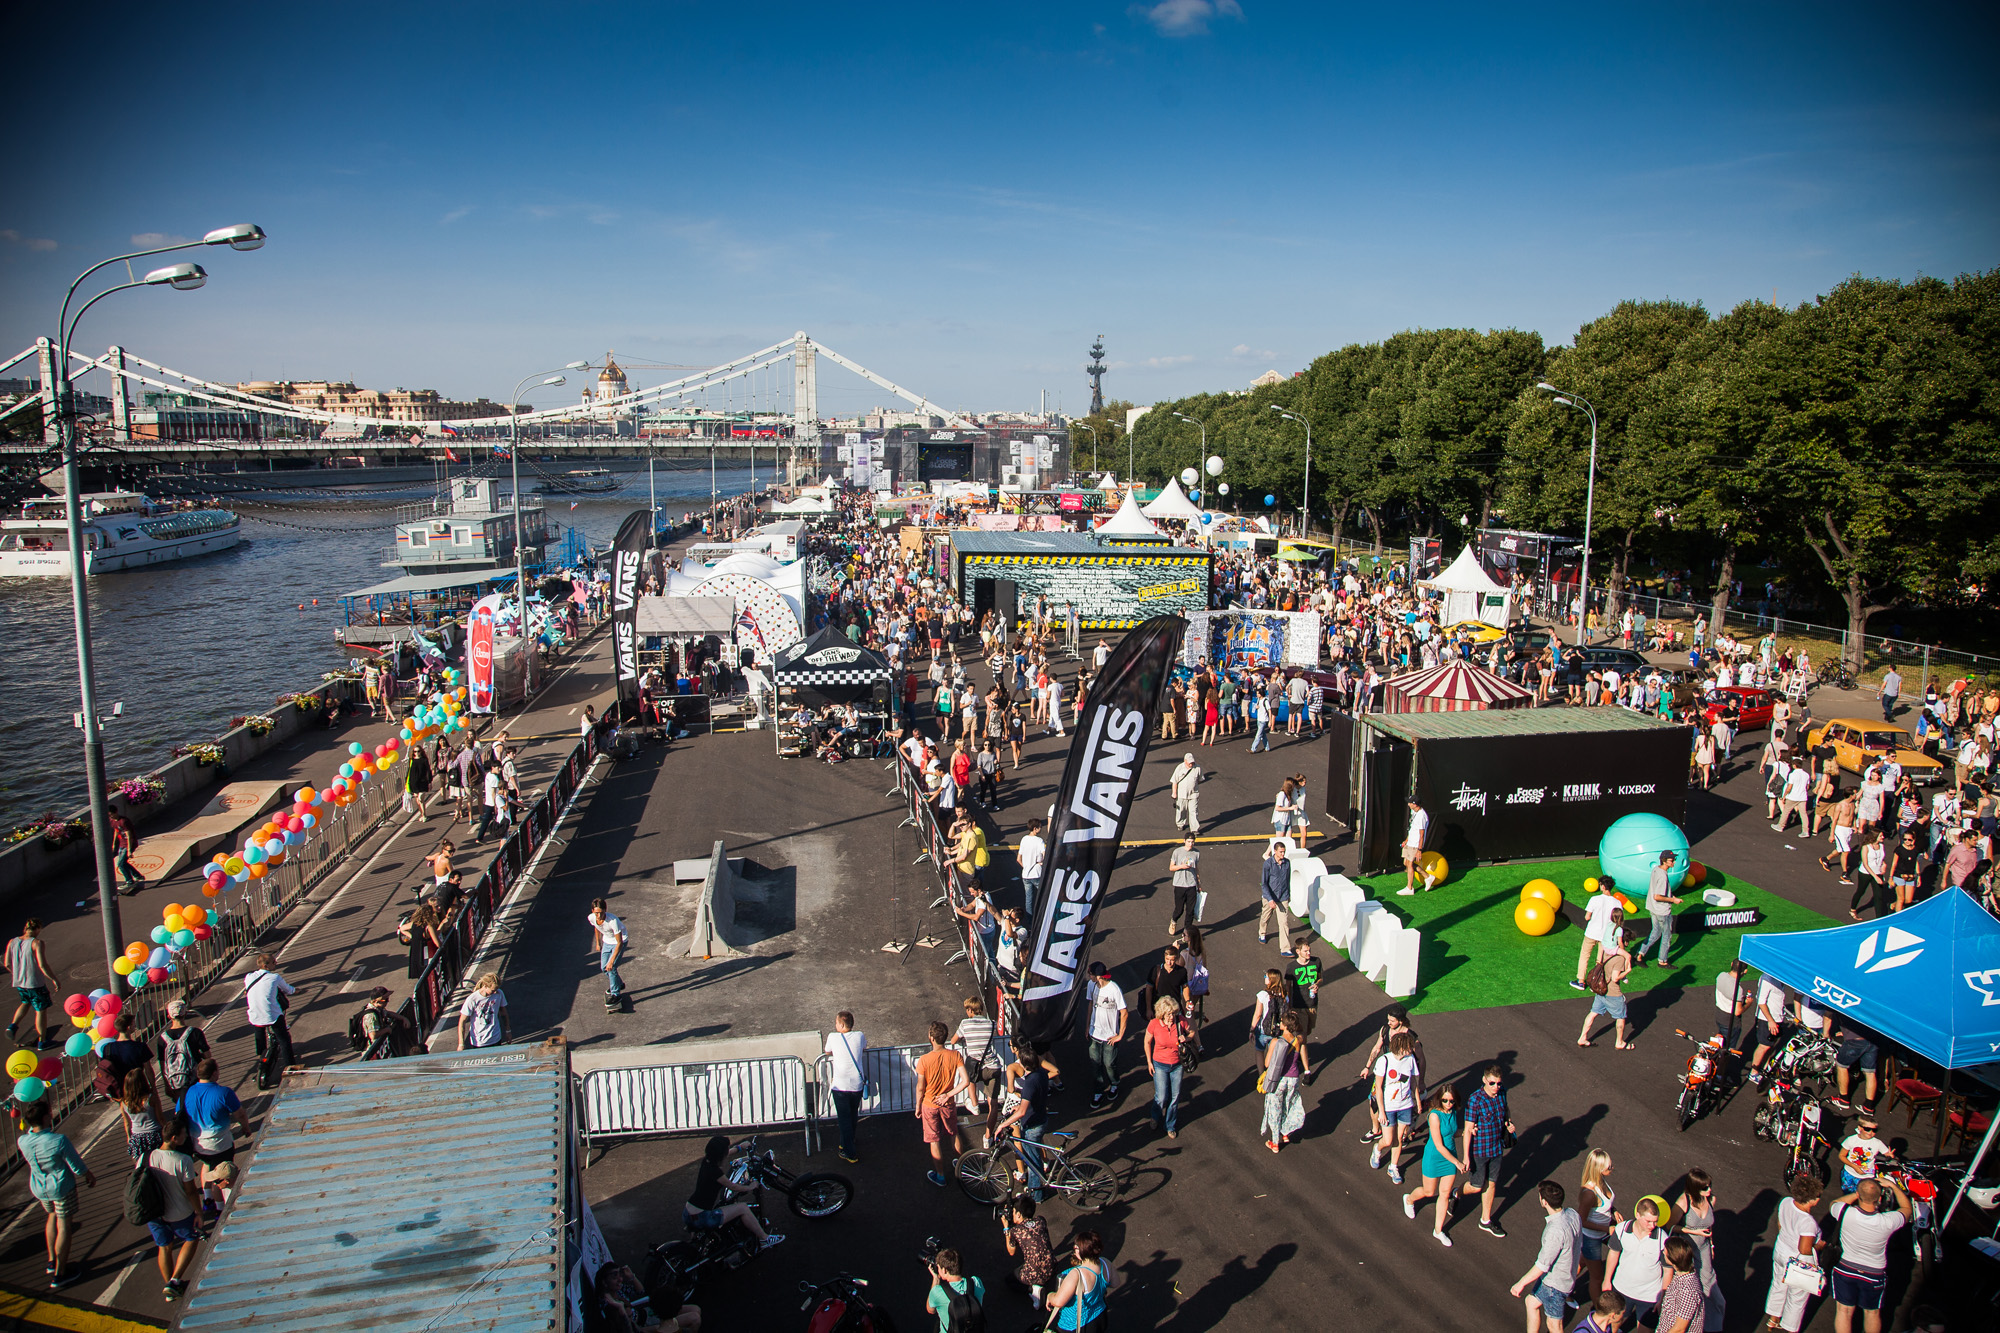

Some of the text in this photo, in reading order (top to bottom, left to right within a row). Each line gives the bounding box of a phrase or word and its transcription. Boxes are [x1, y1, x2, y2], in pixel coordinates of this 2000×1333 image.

[875, 476, 888, 484] LIFE
[614, 550, 640, 612] VANS
[1141, 581, 1196, 598] RESTRICTED AREA
[616, 620, 636, 681] VANS
[820, 648, 841, 657] VANS
[660, 699, 675, 707] OFF
[1062, 703, 1145, 844] VANS
[1517, 786, 1545, 798] Faces
[1618, 783, 1656, 795] KIXBOX
[1022, 868, 1100, 1002] VANS
[1294, 965, 1318, 986] 25
[501, 1053, 526, 1062] GESU
